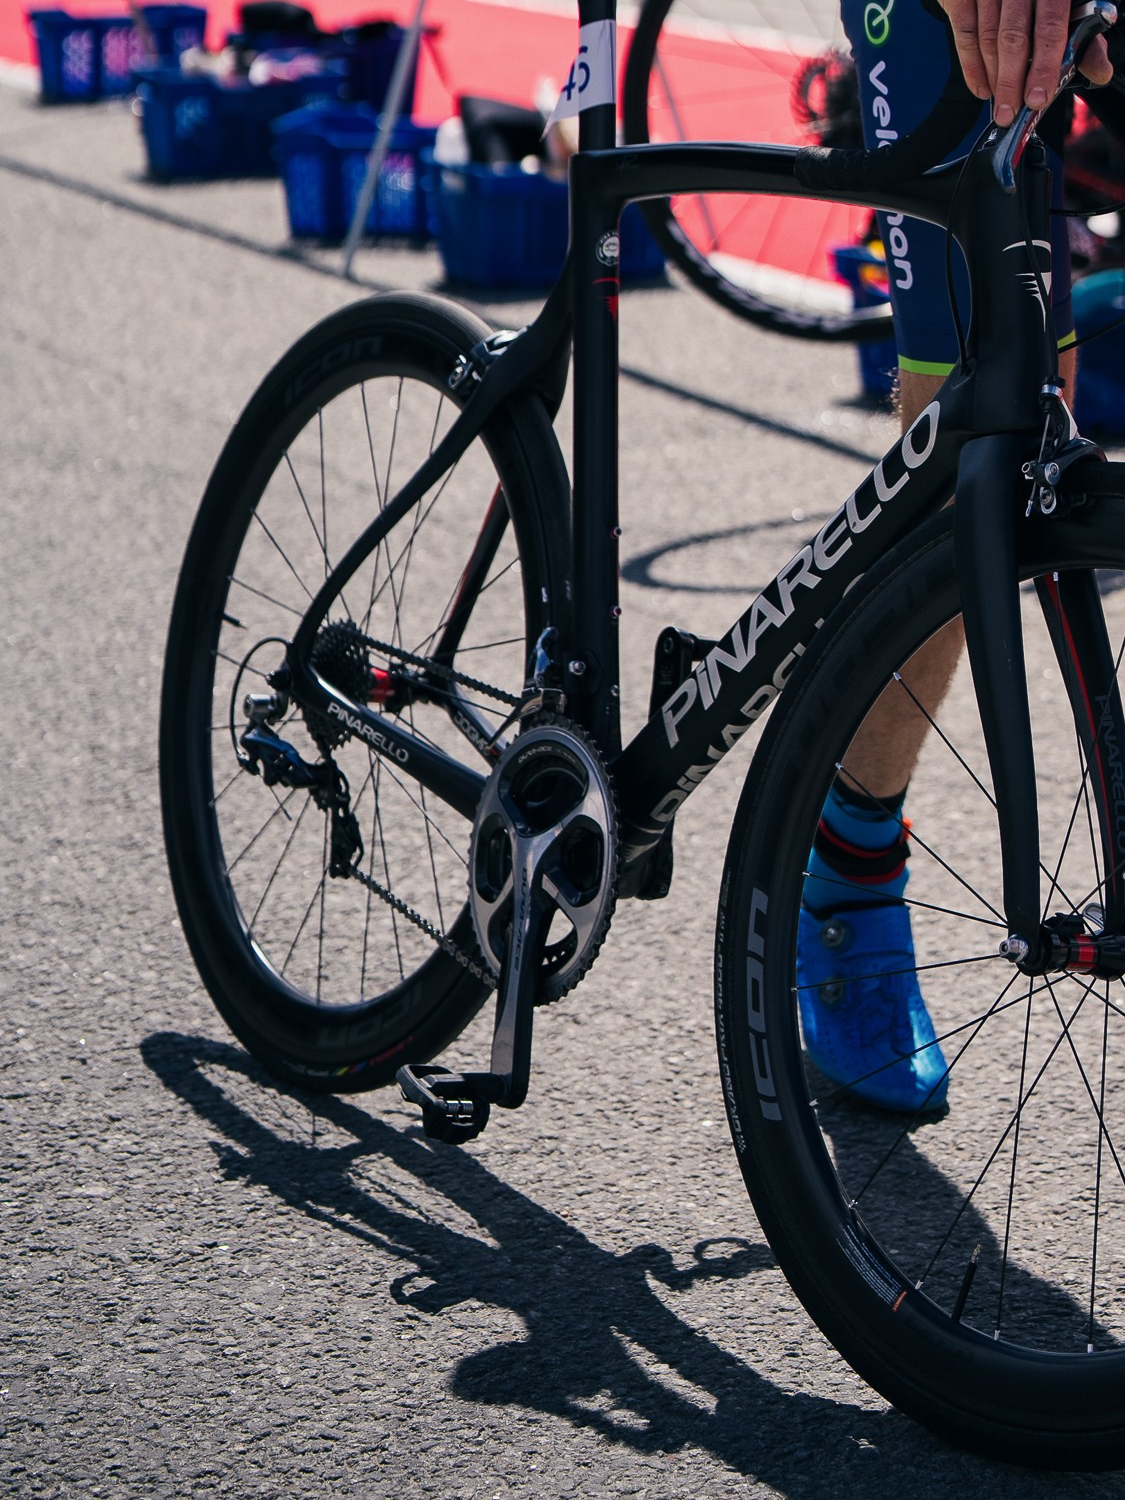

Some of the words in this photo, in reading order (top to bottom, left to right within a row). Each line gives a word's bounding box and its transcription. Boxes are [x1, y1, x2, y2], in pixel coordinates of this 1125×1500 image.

[661, 400, 941, 749] PINARELLO
[326, 701, 410, 764] PINARELLO
[719, 1013, 729, 1062] PRIX
[720, 1062, 743, 1134] GRAND
